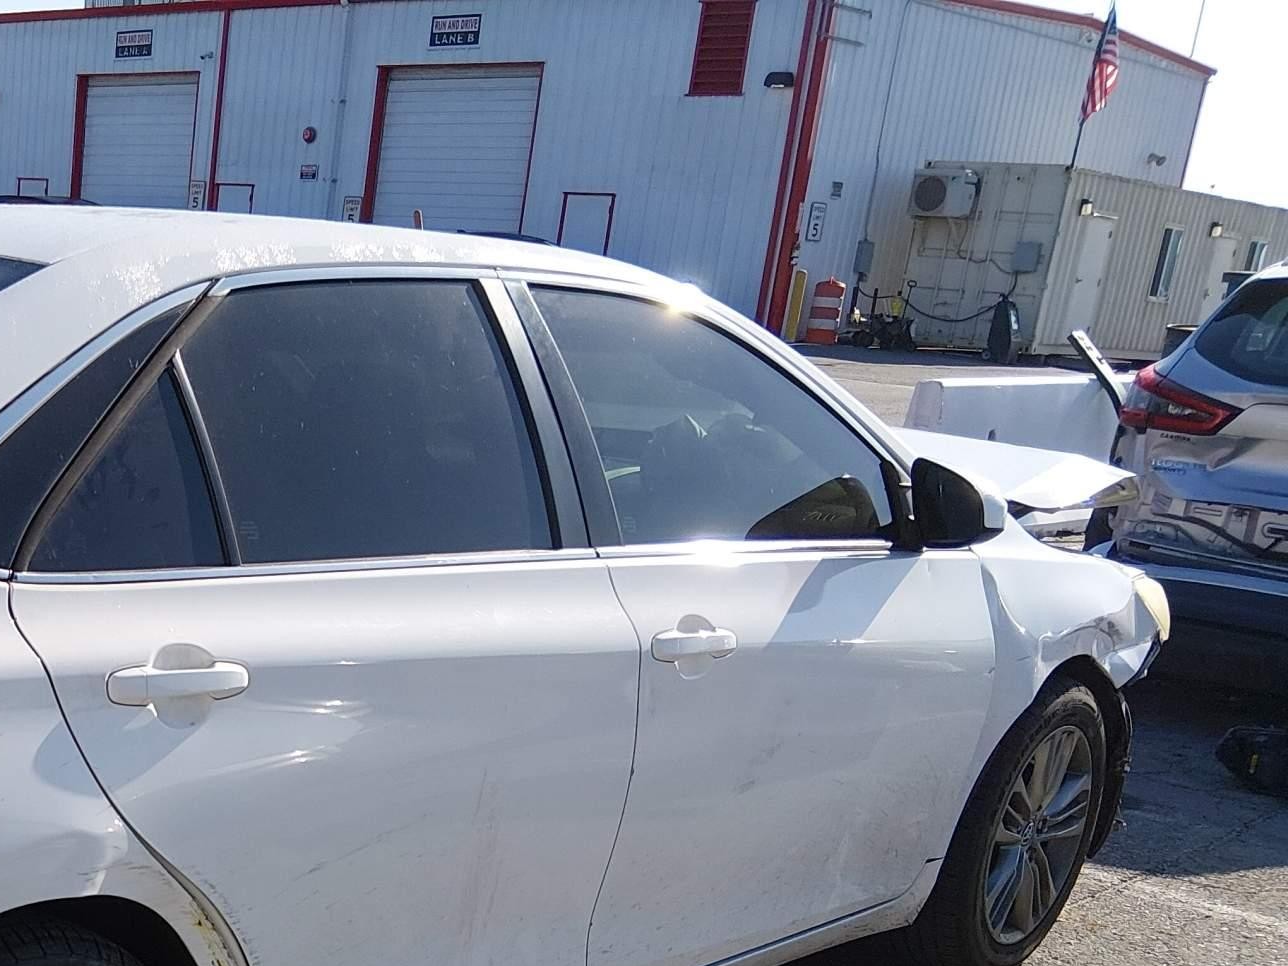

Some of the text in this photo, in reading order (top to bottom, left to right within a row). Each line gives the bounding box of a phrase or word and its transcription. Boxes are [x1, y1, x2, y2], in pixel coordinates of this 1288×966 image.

[435, 18, 478, 31] RUN AND DRIVE
[435, 33, 474, 44] LANE B
[118, 47, 139, 57] LANE
[192, 196, 199, 208] 5
[348, 213, 355, 223] 5
[812, 223, 819, 237] 5
